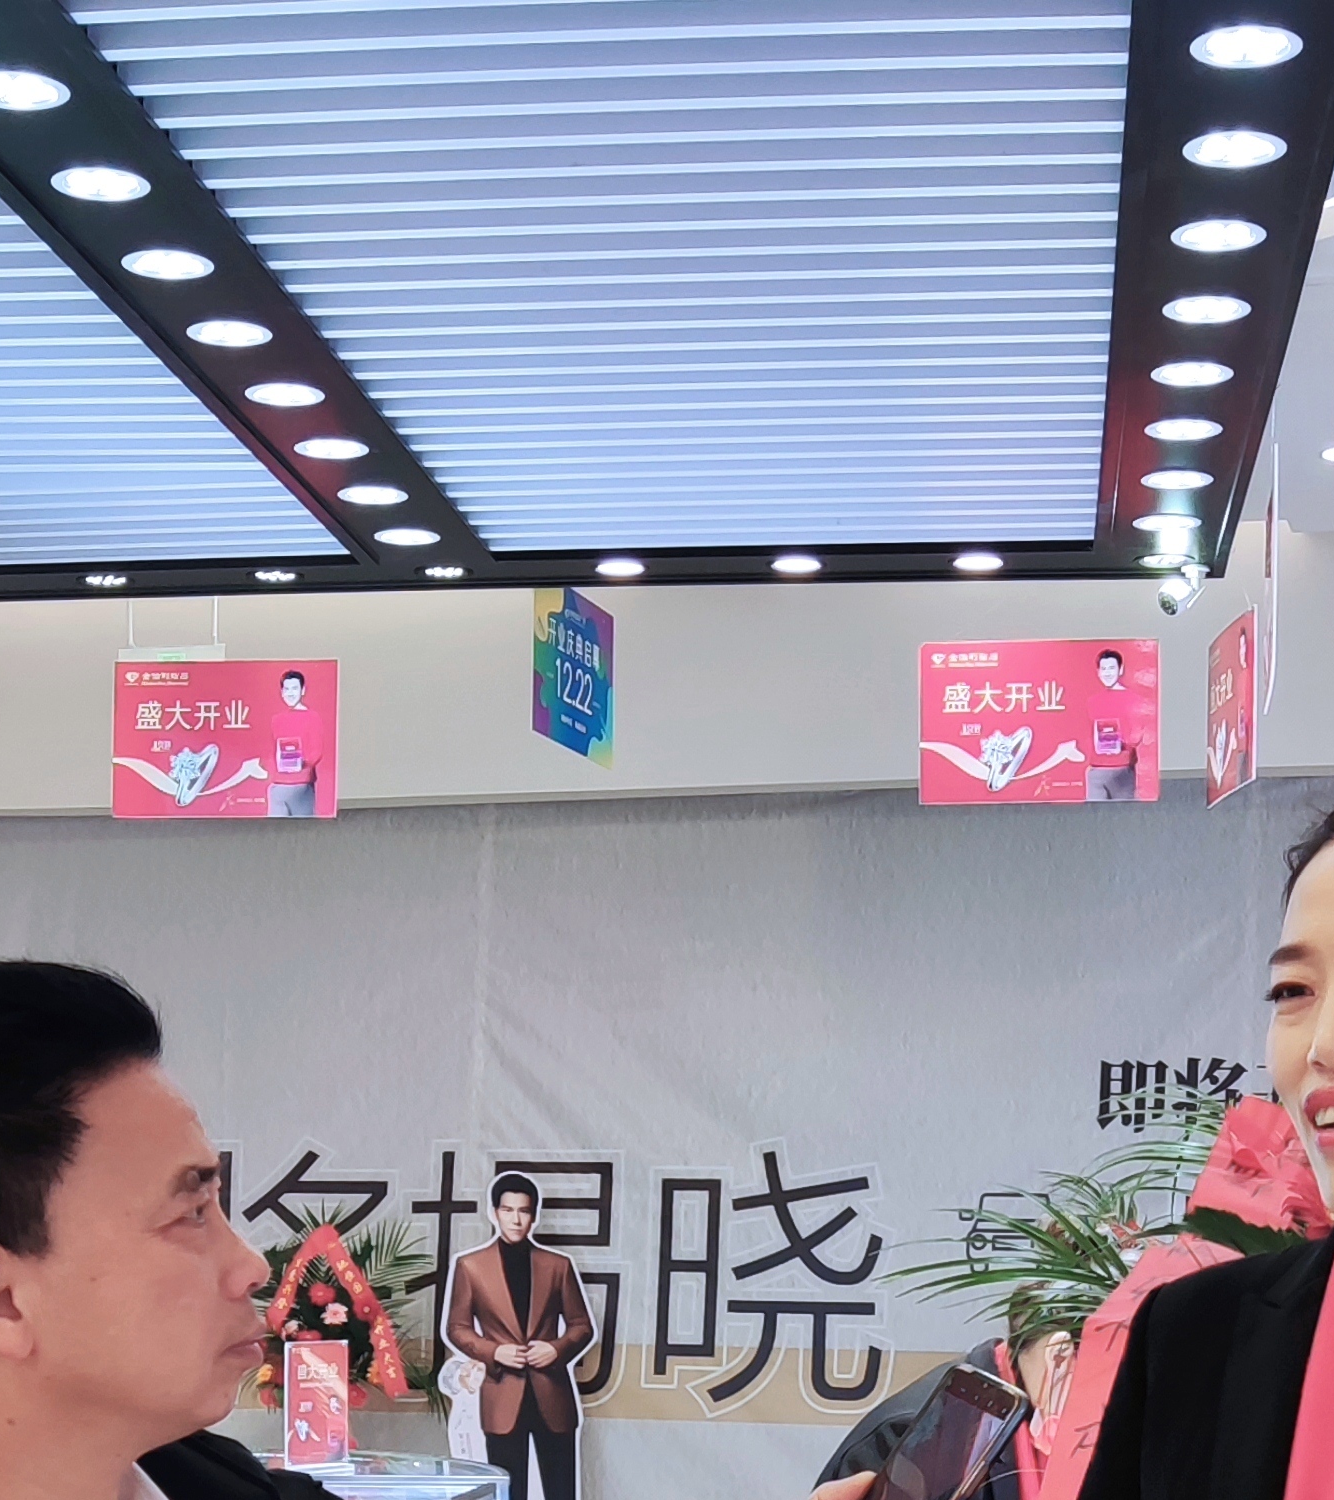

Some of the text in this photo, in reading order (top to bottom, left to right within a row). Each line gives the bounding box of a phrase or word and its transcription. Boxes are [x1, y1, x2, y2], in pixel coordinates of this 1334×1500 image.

[555, 656, 593, 716] 12.22
[942, 680, 1066, 713] 盛大开业
[135, 700, 251, 731] 盛大开业
